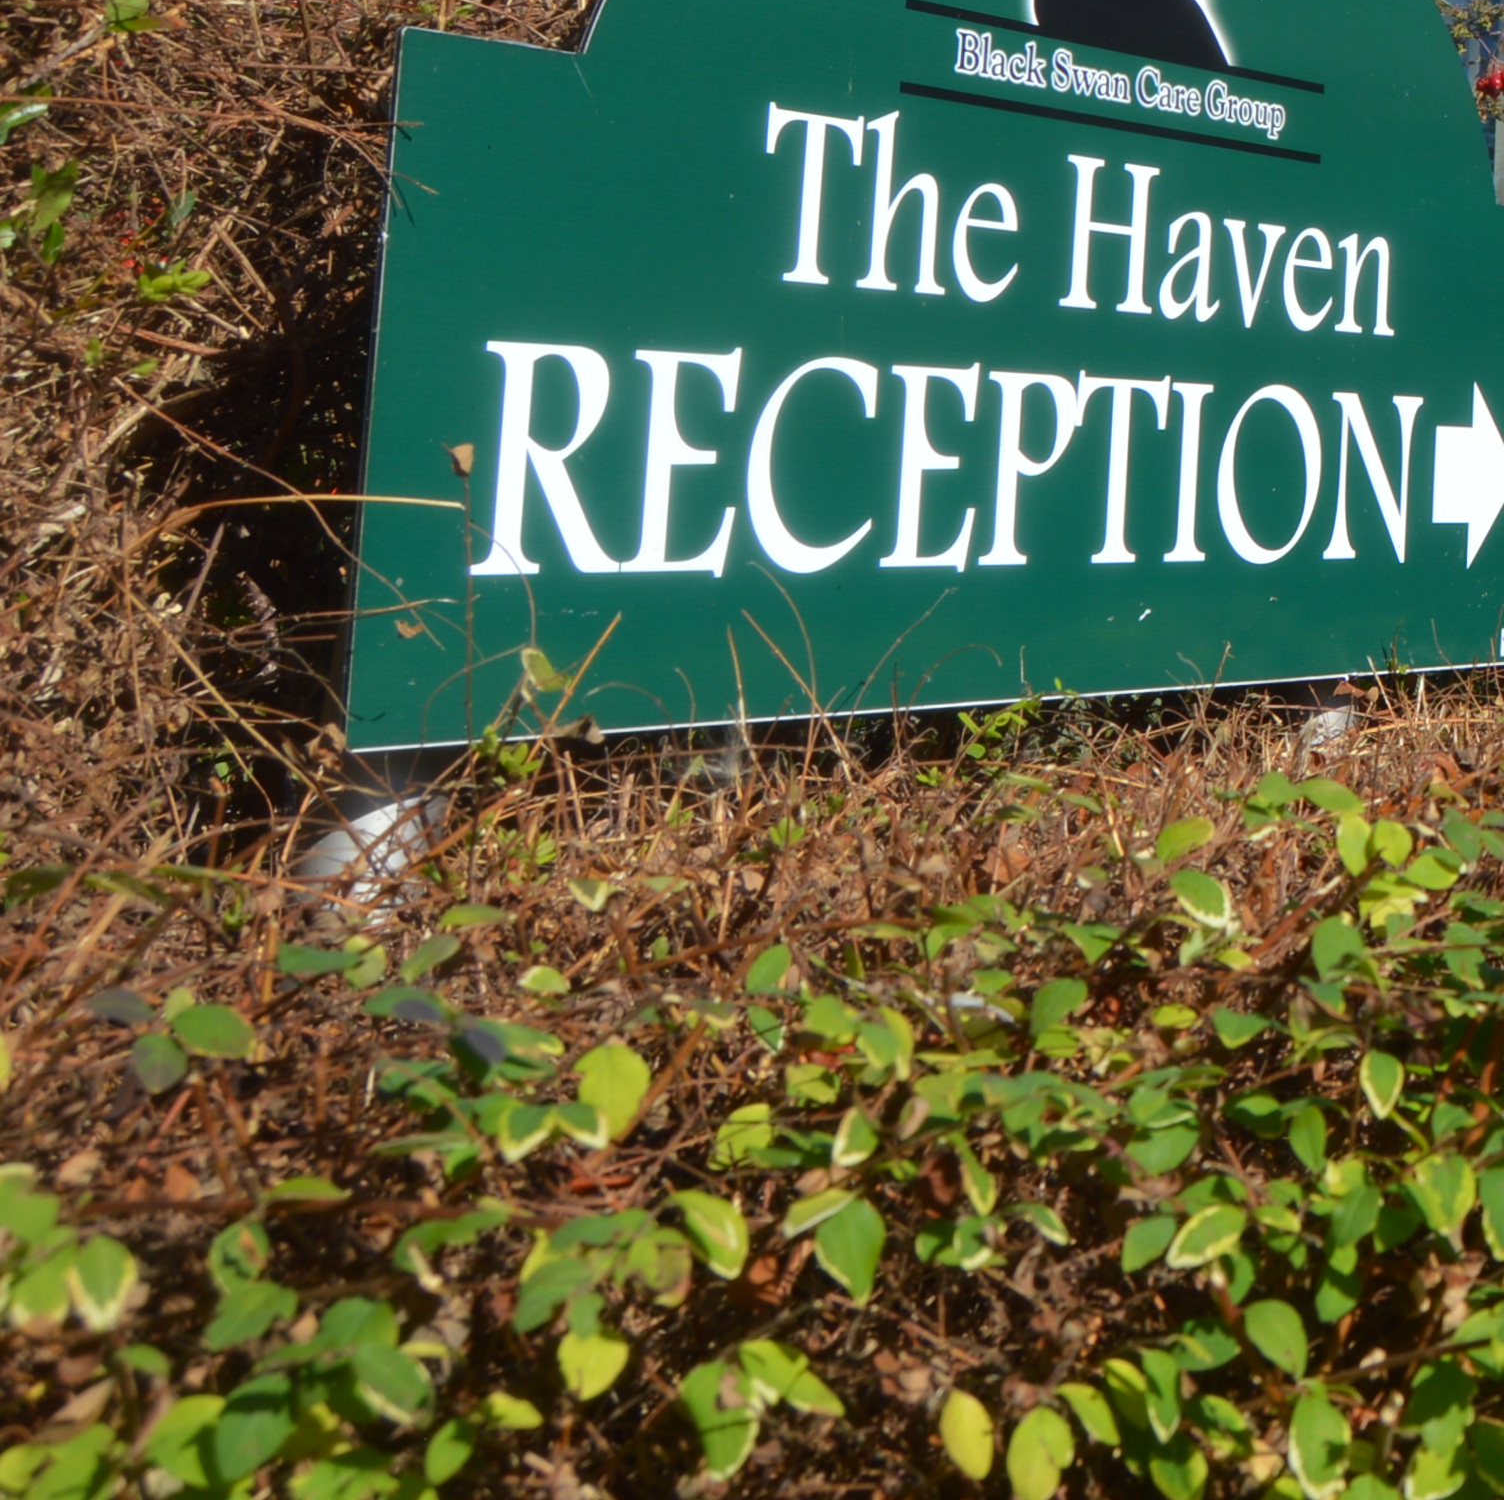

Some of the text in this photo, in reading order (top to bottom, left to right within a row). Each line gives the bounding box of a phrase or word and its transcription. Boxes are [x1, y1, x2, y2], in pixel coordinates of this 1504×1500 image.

[955, 28, 1285, 140] Black Swan Care Group
[766, 101, 1395, 337] The Haven
[469, 340, 1424, 578] RECEPTION
